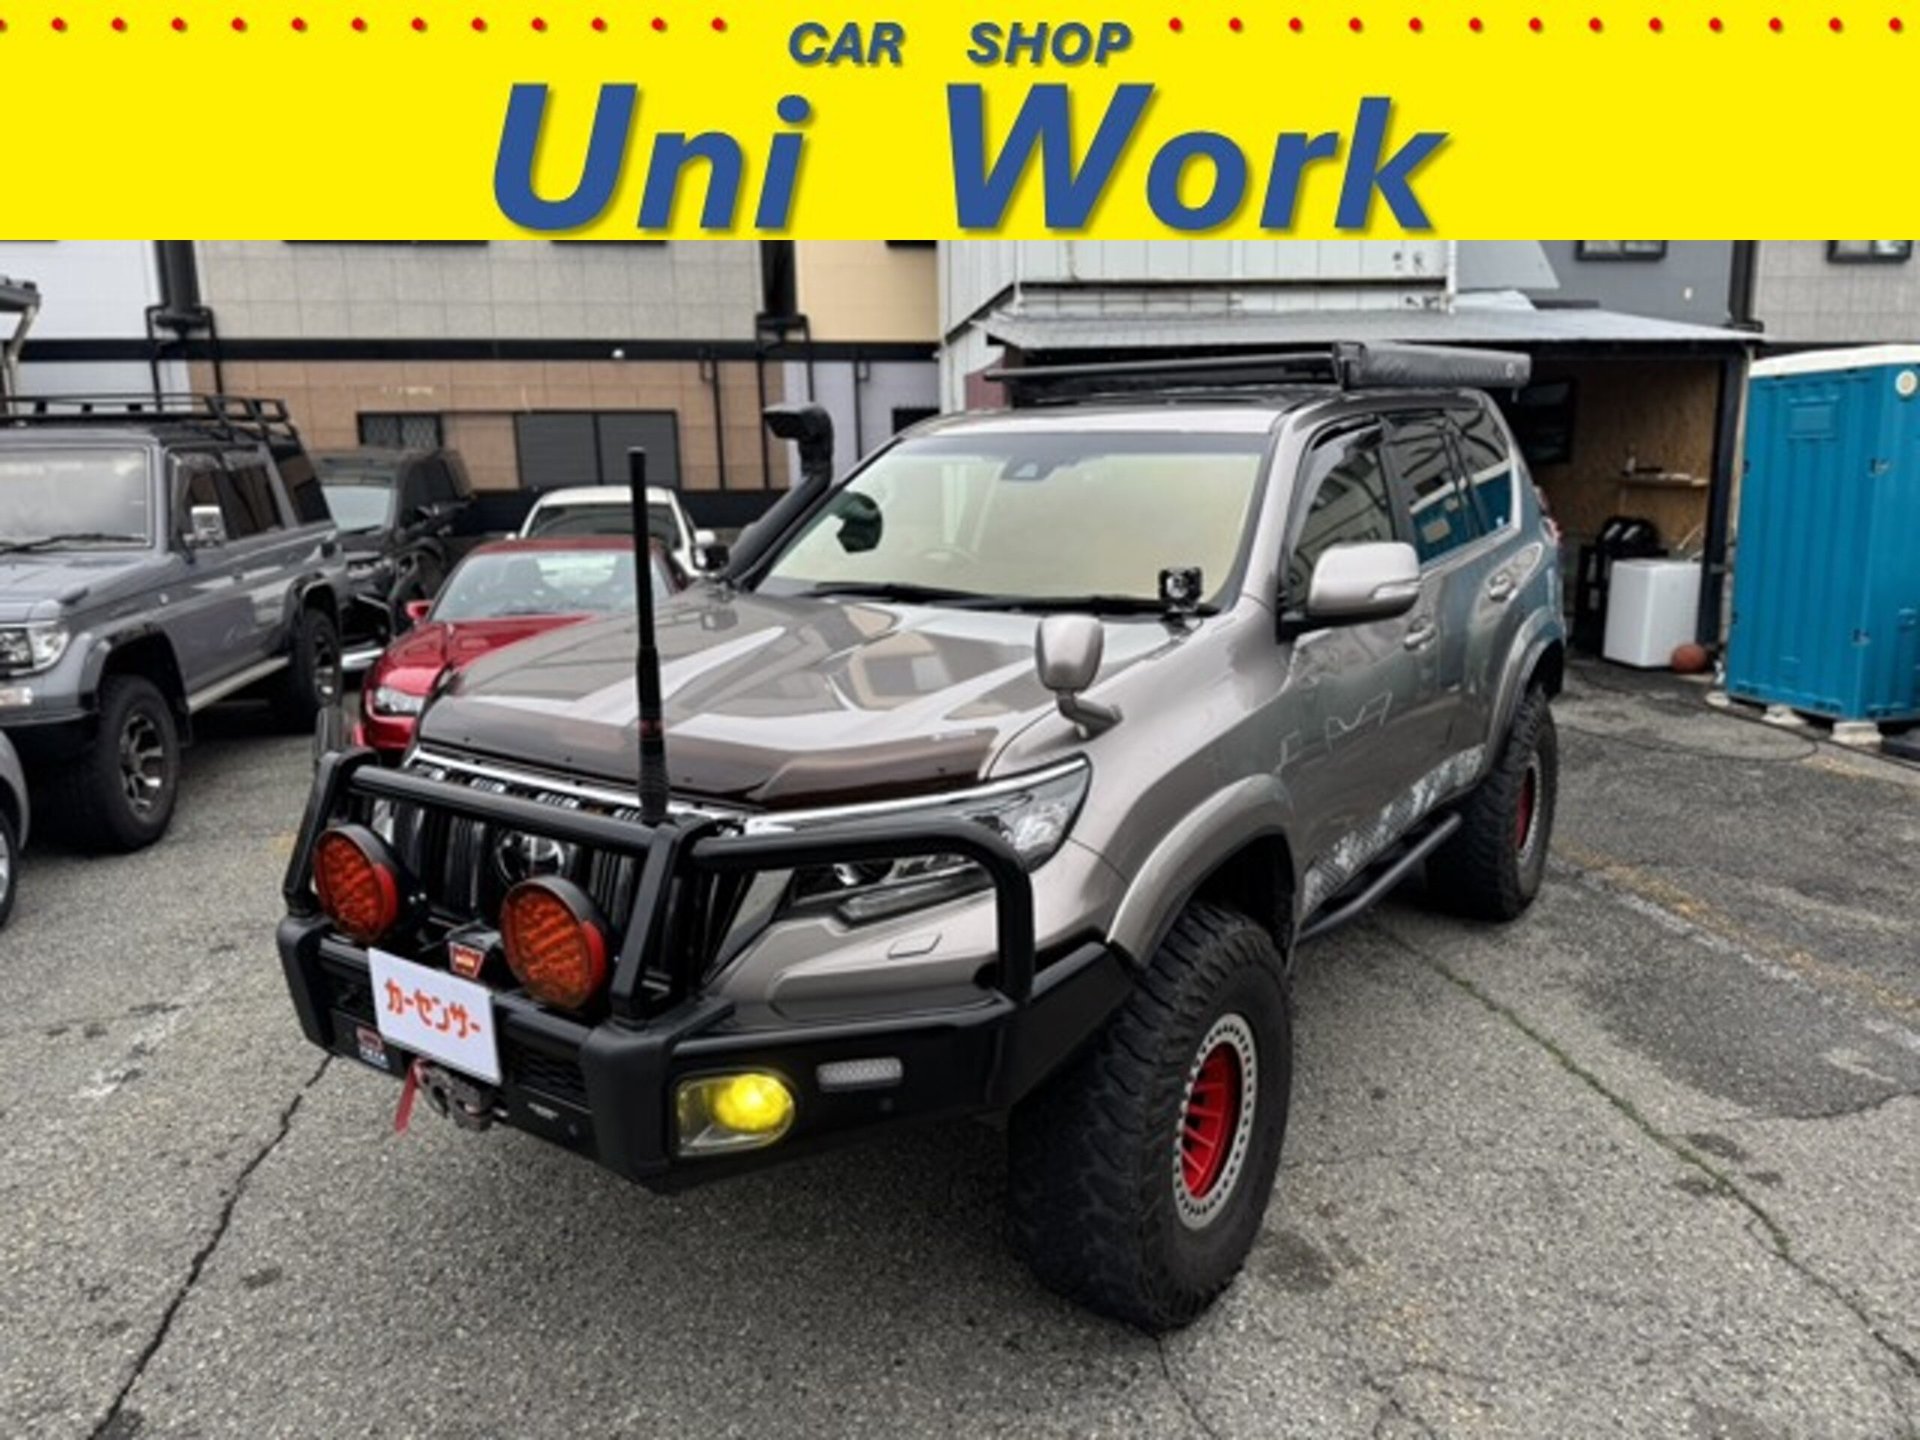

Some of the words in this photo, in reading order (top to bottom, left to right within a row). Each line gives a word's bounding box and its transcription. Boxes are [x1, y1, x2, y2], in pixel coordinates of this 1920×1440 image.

[384, 977, 482, 1039] カーセンサー
